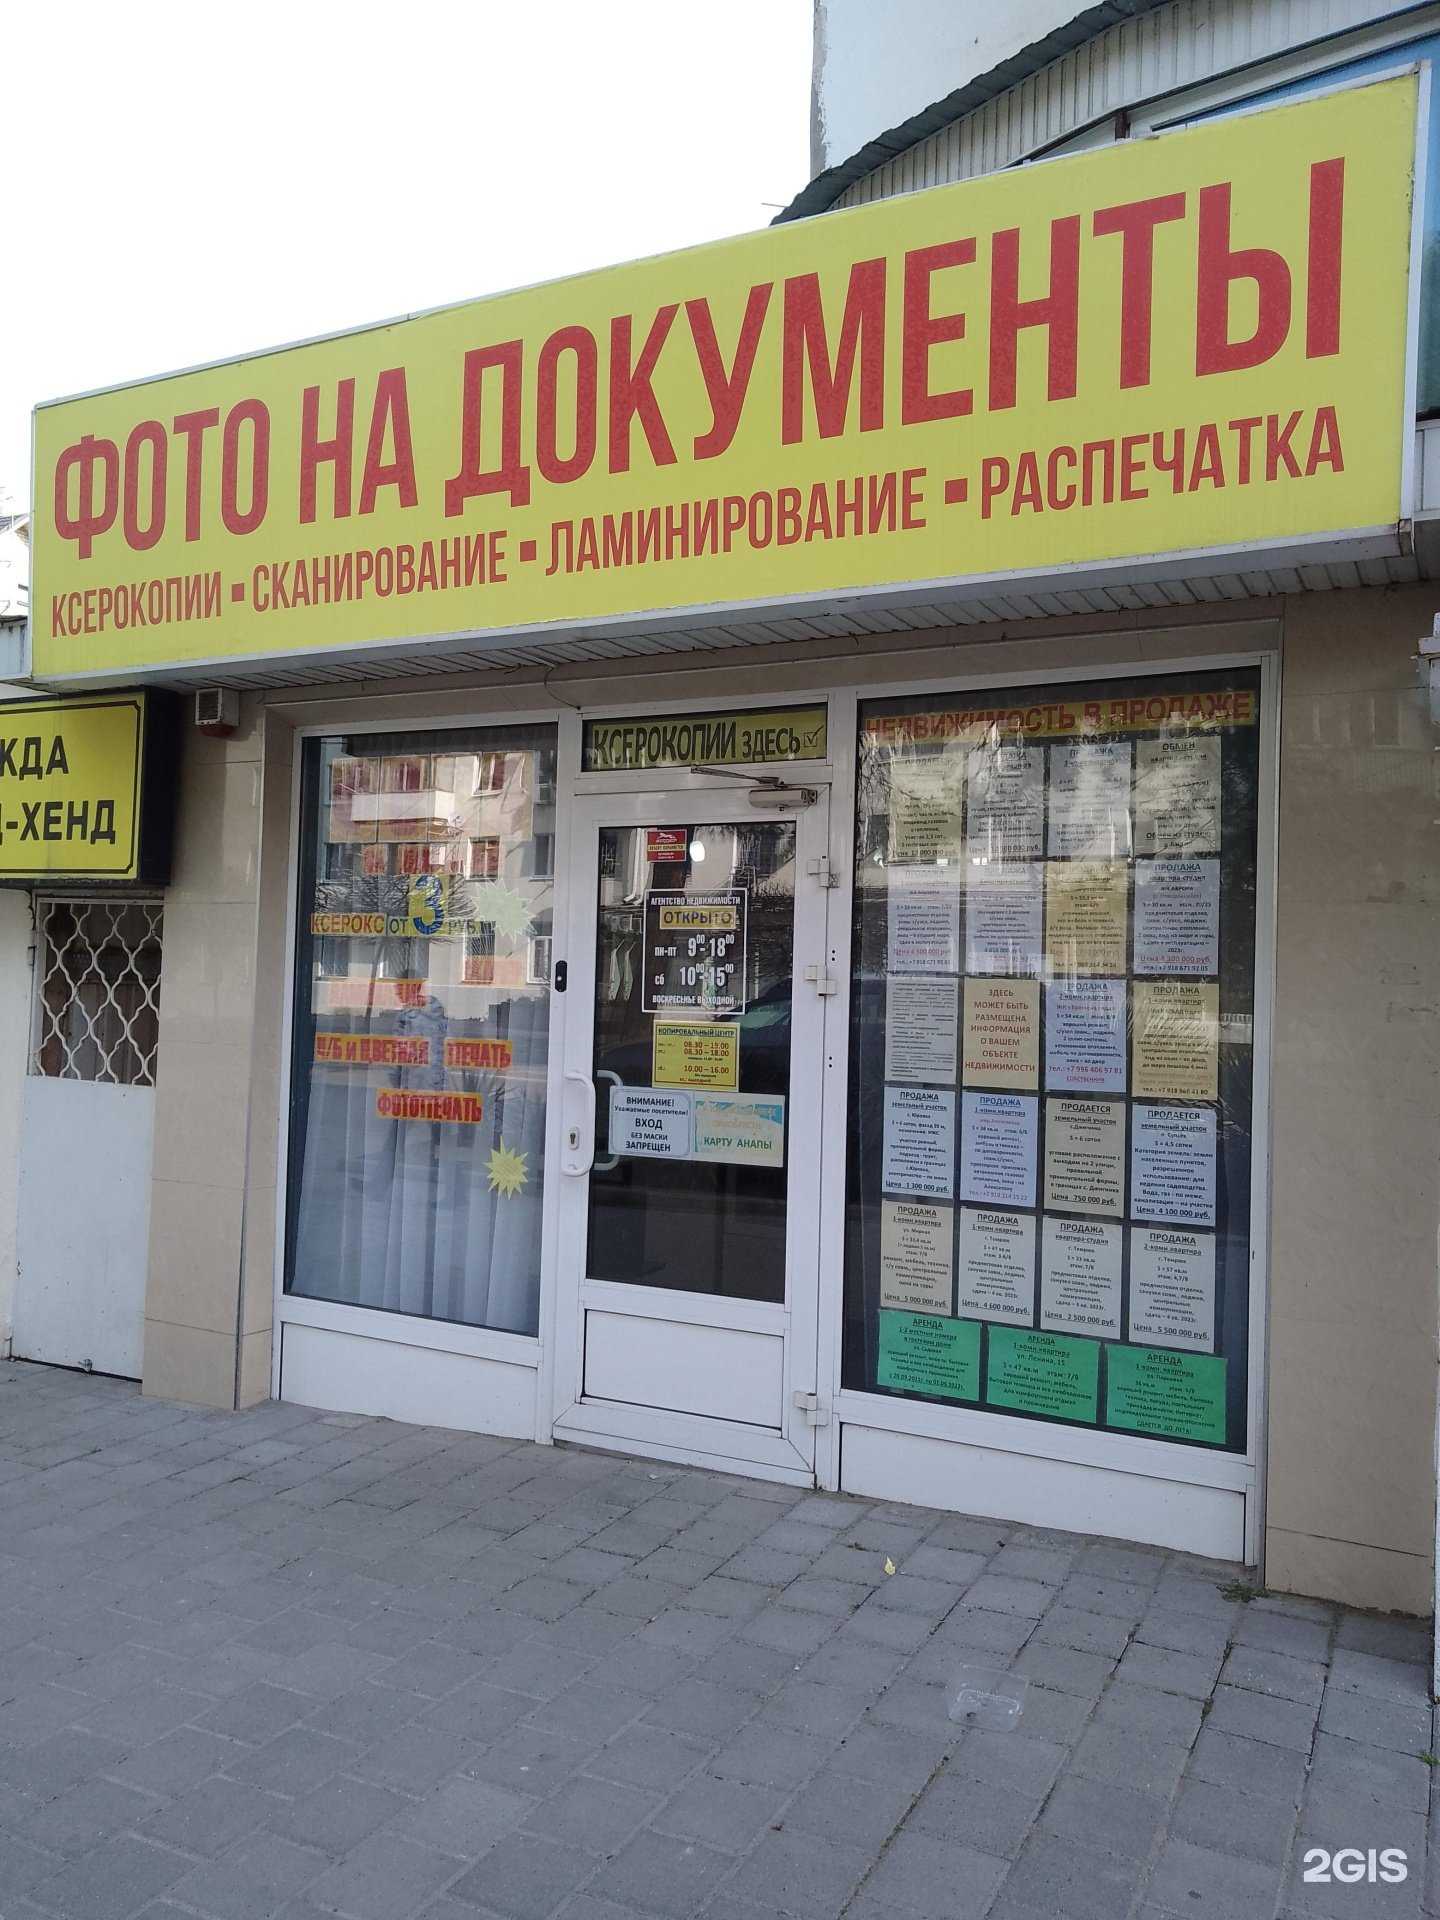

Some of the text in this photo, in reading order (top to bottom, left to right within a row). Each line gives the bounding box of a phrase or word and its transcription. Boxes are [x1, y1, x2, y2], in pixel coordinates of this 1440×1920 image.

[53, 156, 1346, 560] ФОТО НА ДОКУМЕНТЫ
[52, 404, 1345, 638] КСЕРОКОПИИ СКАНИРОВАНИЕ ЛАМИНИРОВАНИЕ РАСПЕЧАТКА
[1110, 693, 1250, 726] ПРОДАЖЕ
[593, 721, 800, 765] КСЕРОКОПИИ ЗДЕСЬ
[1163, 743, 1195, 751] ОБМЕН
[0, 800, 116, 845] -ХЕНД
[312, 912, 385, 934] КСЕРОКС
[389, 917, 408, 934] ОТ
[413, 875, 445, 935] 3
[651, 897, 740, 906] АГЕНТСТВО НЕДВИЖИМОСТИ
[664, 911, 731, 924] ОТКРЫТО
[655, 973, 665, 985] сб
[989, 989, 1014, 997] ЗДЕСЬ
[1153, 986, 1200, 995] ПРОДАЖА
[653, 995, 734, 1005] ВОСКРЕСЕНЬЕ ВЫХОДНОЙ
[1006, 1002, 1028, 1010] БЫТЬ
[976, 1014, 1026, 1023] РАЗМЕЩЕНА
[659, 1028, 714, 1036] КОПИРОВАЛЬНЫЙ
[971, 1025, 1031, 1035] ИНФОРМАЦИЯ
[989, 1038, 1020, 1046] ВАШЕМ
[360, 1039, 429, 1065] ЦВЕТНАЯ
[982, 1051, 1018, 1059] ОБЪЕКТЕ
[965, 1063, 1035, 1073] НЕДВИЖИМОСТИ
[626, 1097, 674, 1107] ВНИМАНИЕ!
[900, 1092, 939, 1101] ПРОДАЖА
[980, 1096, 1021, 1107] ПРОДАЖА
[377, 1093, 482, 1123] ФОТОПЕЧАТЬ
[615, 1106, 650, 1114] Уважаемые
[1060, 1103, 1111, 1114] ПРОДАЕТСЯ
[1148, 1110, 1200, 1120] ПРОДАЕТСЯ
[635, 1118, 663, 1129] ВХОД
[644, 1133, 668, 1141] МАСКИ
[626, 1141, 670, 1152] ЗАПРЕЩЕН
[704, 1137, 772, 1149] КАРТУ АНАПЫ
[1051, 1193, 1068, 1201] Цена
[897, 1206, 938, 1218] ПРОДАЖА
[1136, 1206, 1155, 1214] Цена
[1195, 1211, 1210, 1220] руб.
[977, 1213, 1018, 1226] ПРОДАЖА
[1060, 1223, 1104, 1236] ПРОДАЖА
[1150, 1232, 1196, 1246] ПРОДАЖА
[884, 1292, 900, 1301] Цена
[935, 1301, 948, 1309] руб.
[962, 1299, 979, 1307] Цена
[1016, 1307, 1031, 1315] руб.
[913, 1318, 943, 1330] АРЕНДА
[1045, 1310, 1062, 1319] Цена
[1101, 1319, 1116, 1327] руб.
[1133, 1322, 1152, 1332] Цена
[1164, 1327, 1178, 1335] 500
[1178, 1329, 1192, 1337] 000
[1194, 1331, 1210, 1341] руб.
[1027, 1335, 1055, 1346] АРЕНДА
[1147, 1354, 1183, 1367] АРЕНДА
